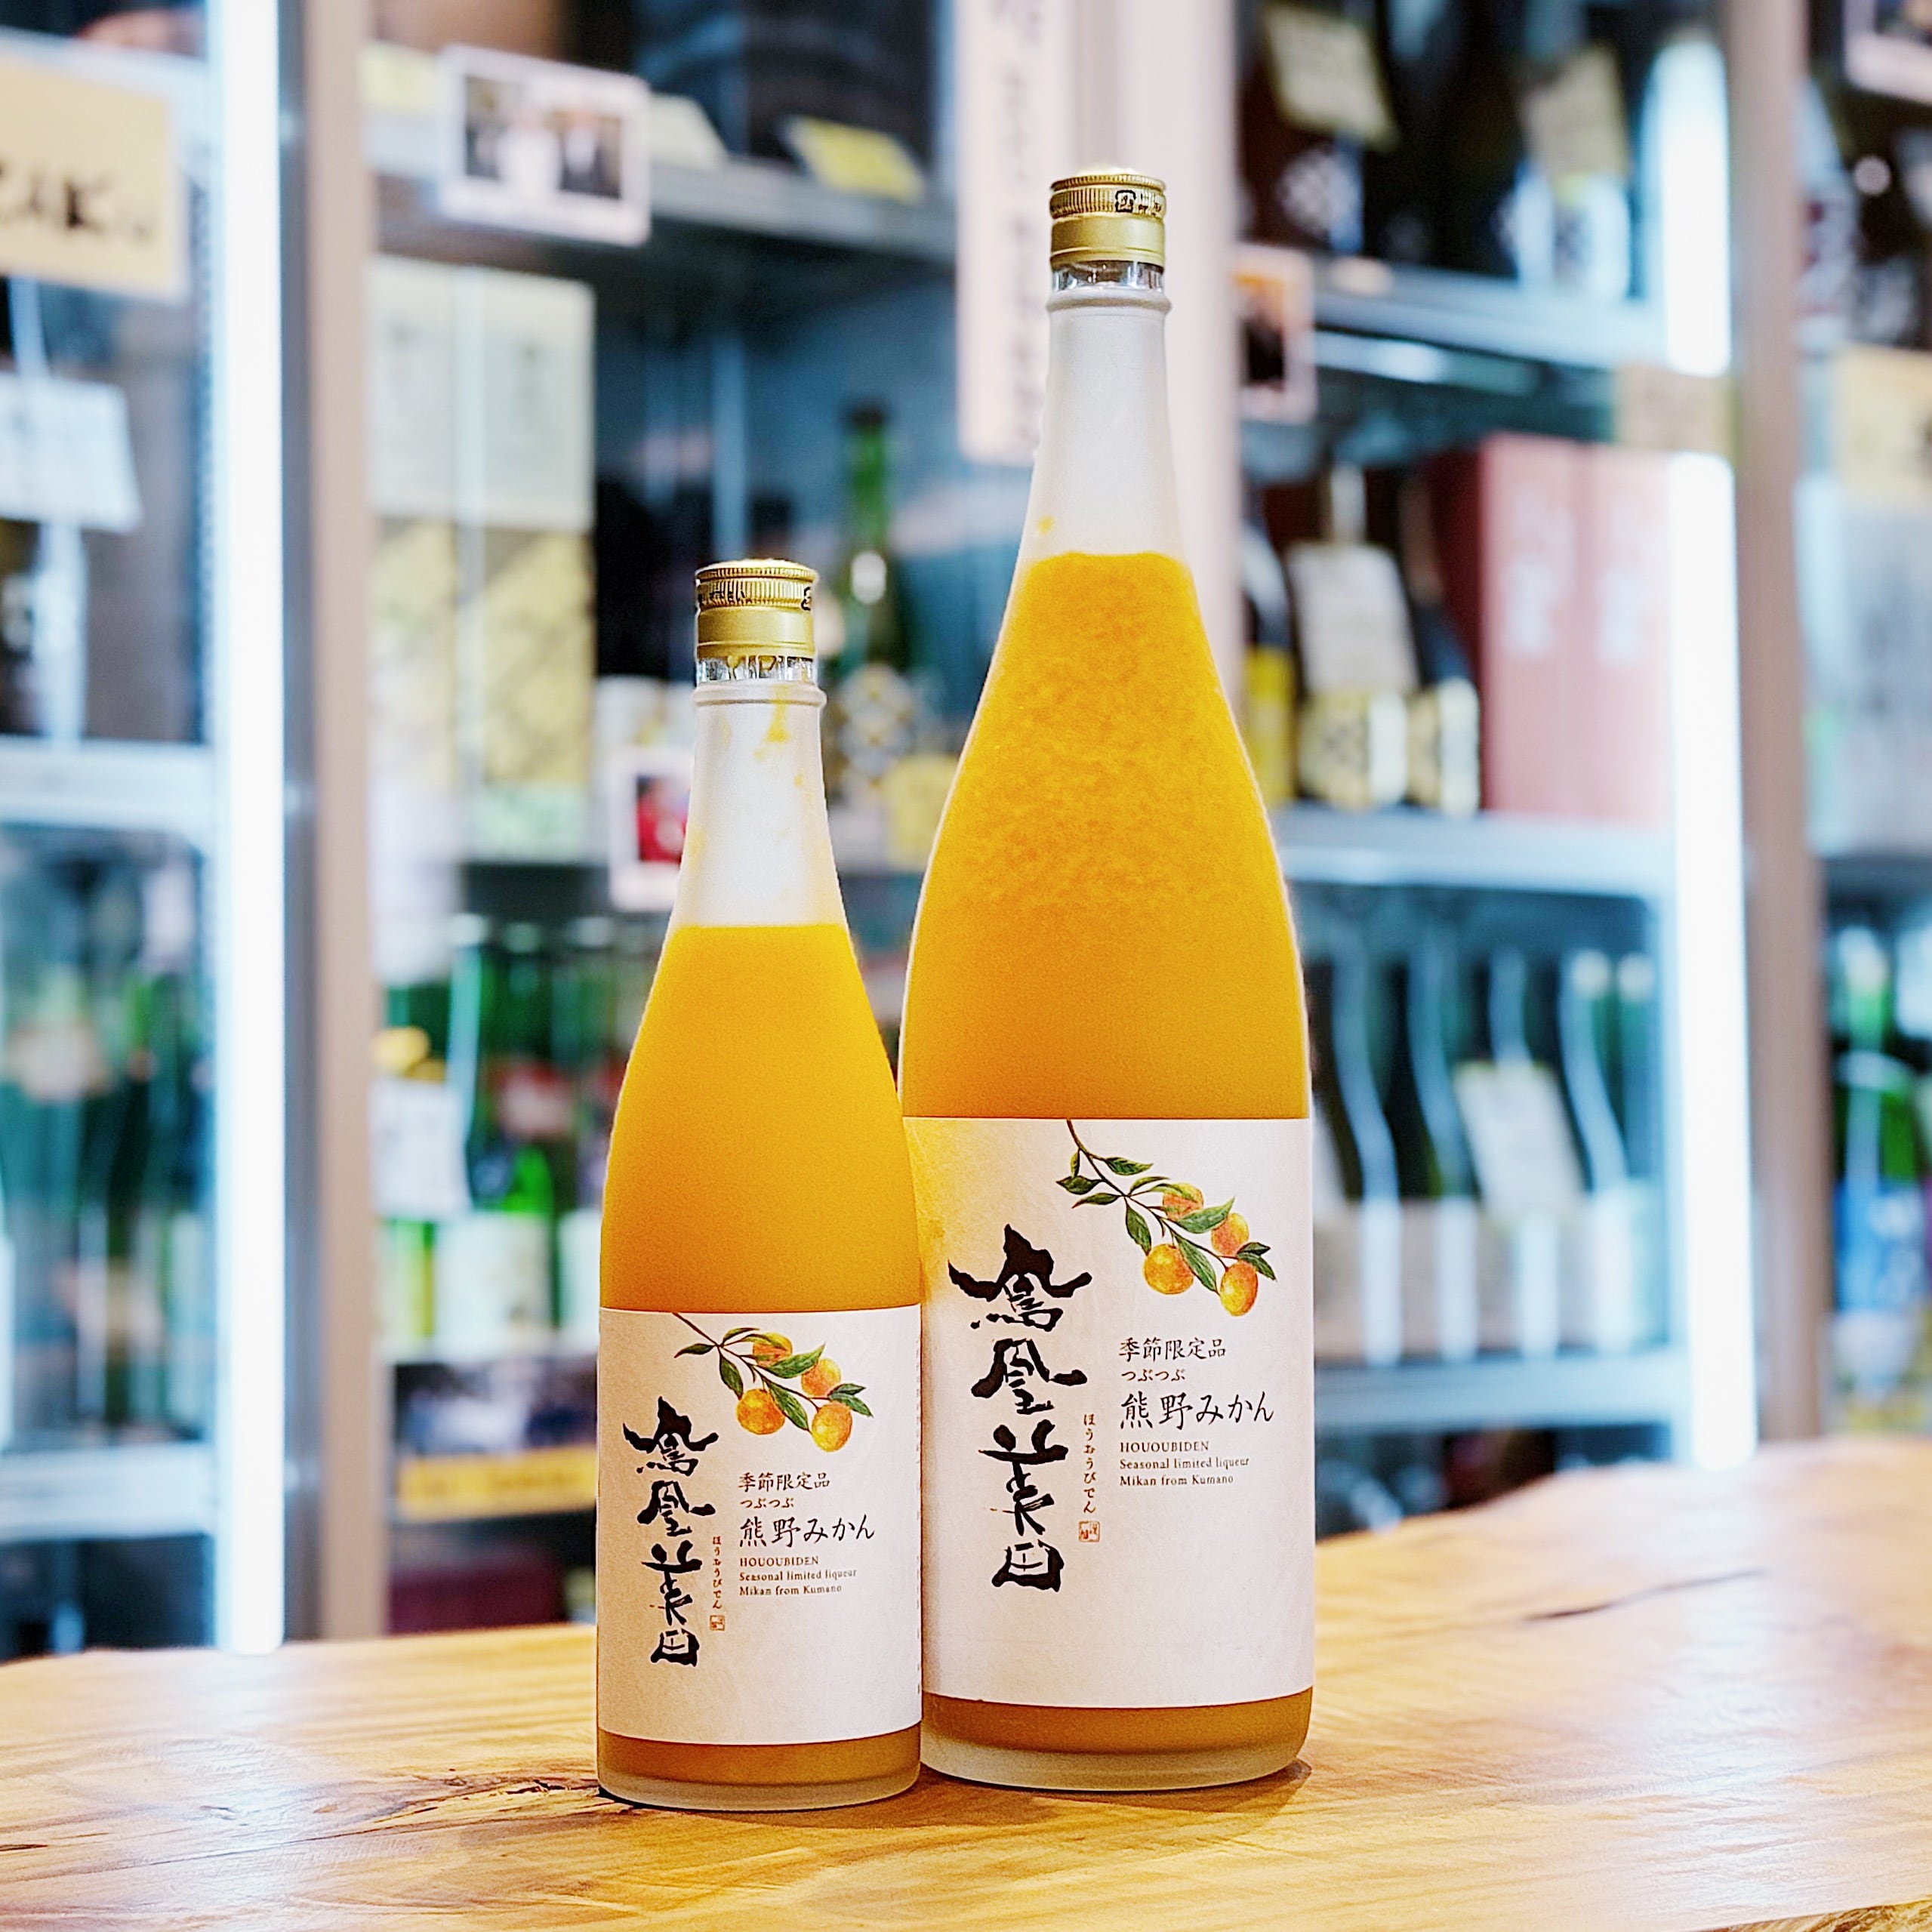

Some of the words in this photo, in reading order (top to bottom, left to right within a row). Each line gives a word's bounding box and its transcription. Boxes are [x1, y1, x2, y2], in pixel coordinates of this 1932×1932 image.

[1118, 1336, 1227, 1362] 季節限定品
[1120, 1368, 1186, 1382] つぶつぶ
[1120, 1391, 1274, 1430] 熊野みかん
[1120, 1441, 1209, 1453] HOUOUBIDEN
[1083, 1413, 1097, 1514] ほうおうびでん
[1119, 1458, 1170, 1470] Seasonal
[1174, 1457, 1212, 1468] limited
[738, 1471, 830, 1493] 季節限定品
[1120, 1475, 1157, 1487] Mikan
[1161, 1475, 1188, 1486] from
[1192, 1474, 1234, 1486] Kumano
[740, 1497, 794, 1509] つぶつぶ
[739, 1514, 876, 1548] 熊野みかん
[740, 1556, 819, 1567] HOUOUBIDEN
[739, 1571, 783, 1582] Seasonal
[787, 1570, 822, 1581] limited
[739, 1585, 772, 1596] Mikan
[775, 1585, 800, 1595] from
[803, 1584, 843, 1595] Kumano
